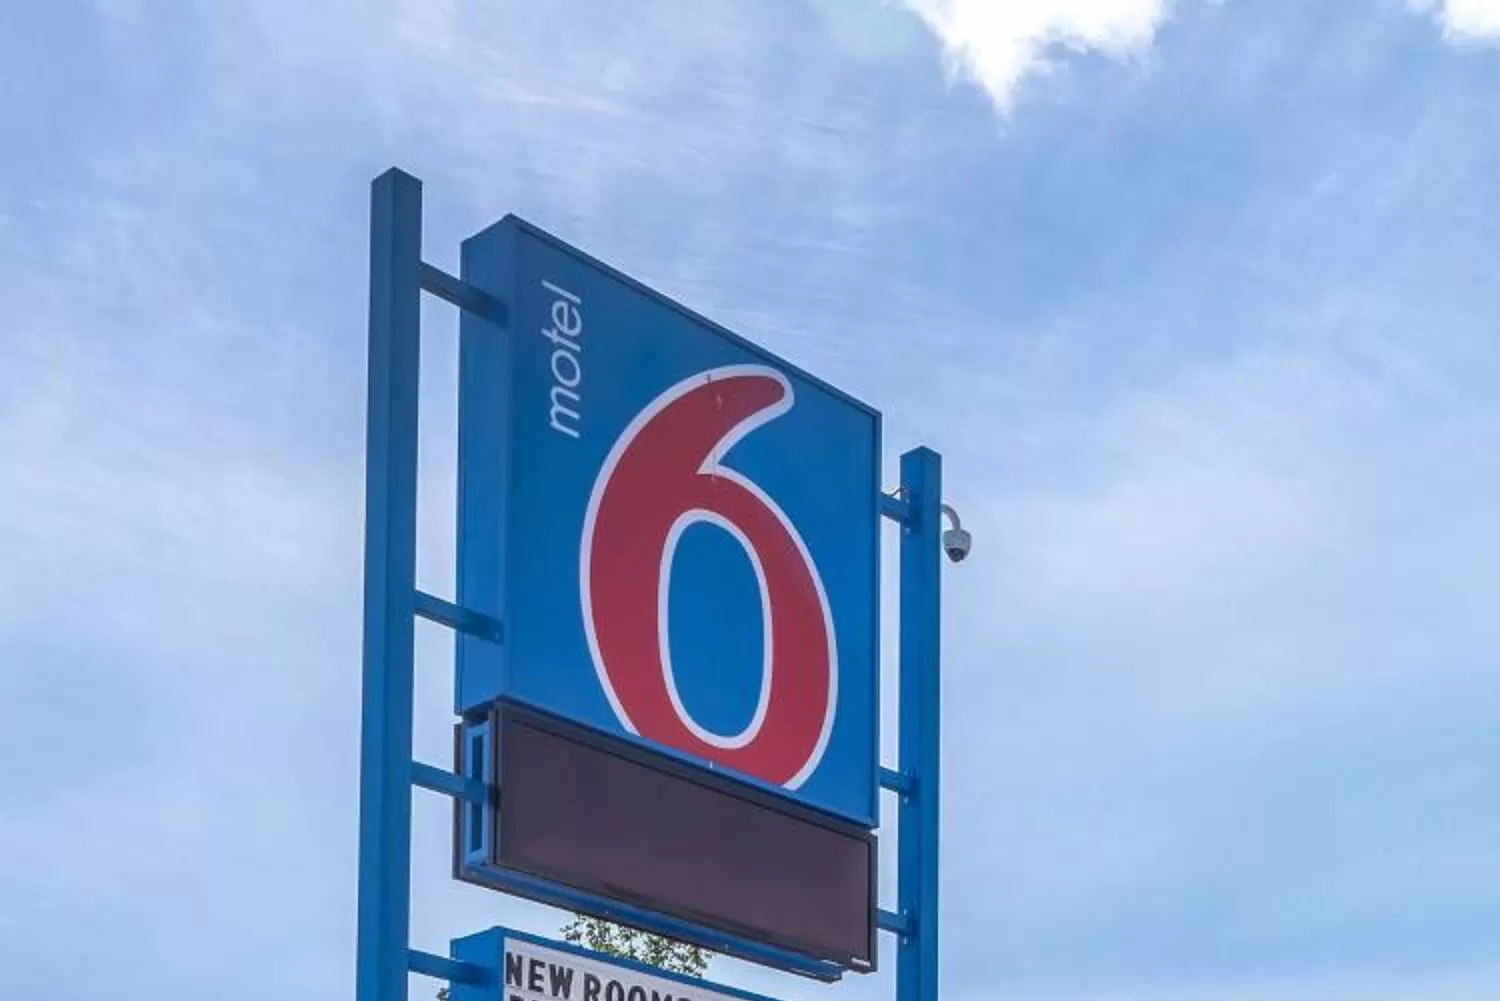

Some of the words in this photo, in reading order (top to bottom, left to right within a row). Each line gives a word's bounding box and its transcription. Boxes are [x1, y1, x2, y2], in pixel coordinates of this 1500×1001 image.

[541, 279, 582, 439] motel
[579, 363, 839, 790] 6
[505, 951, 574, 999] NEW
